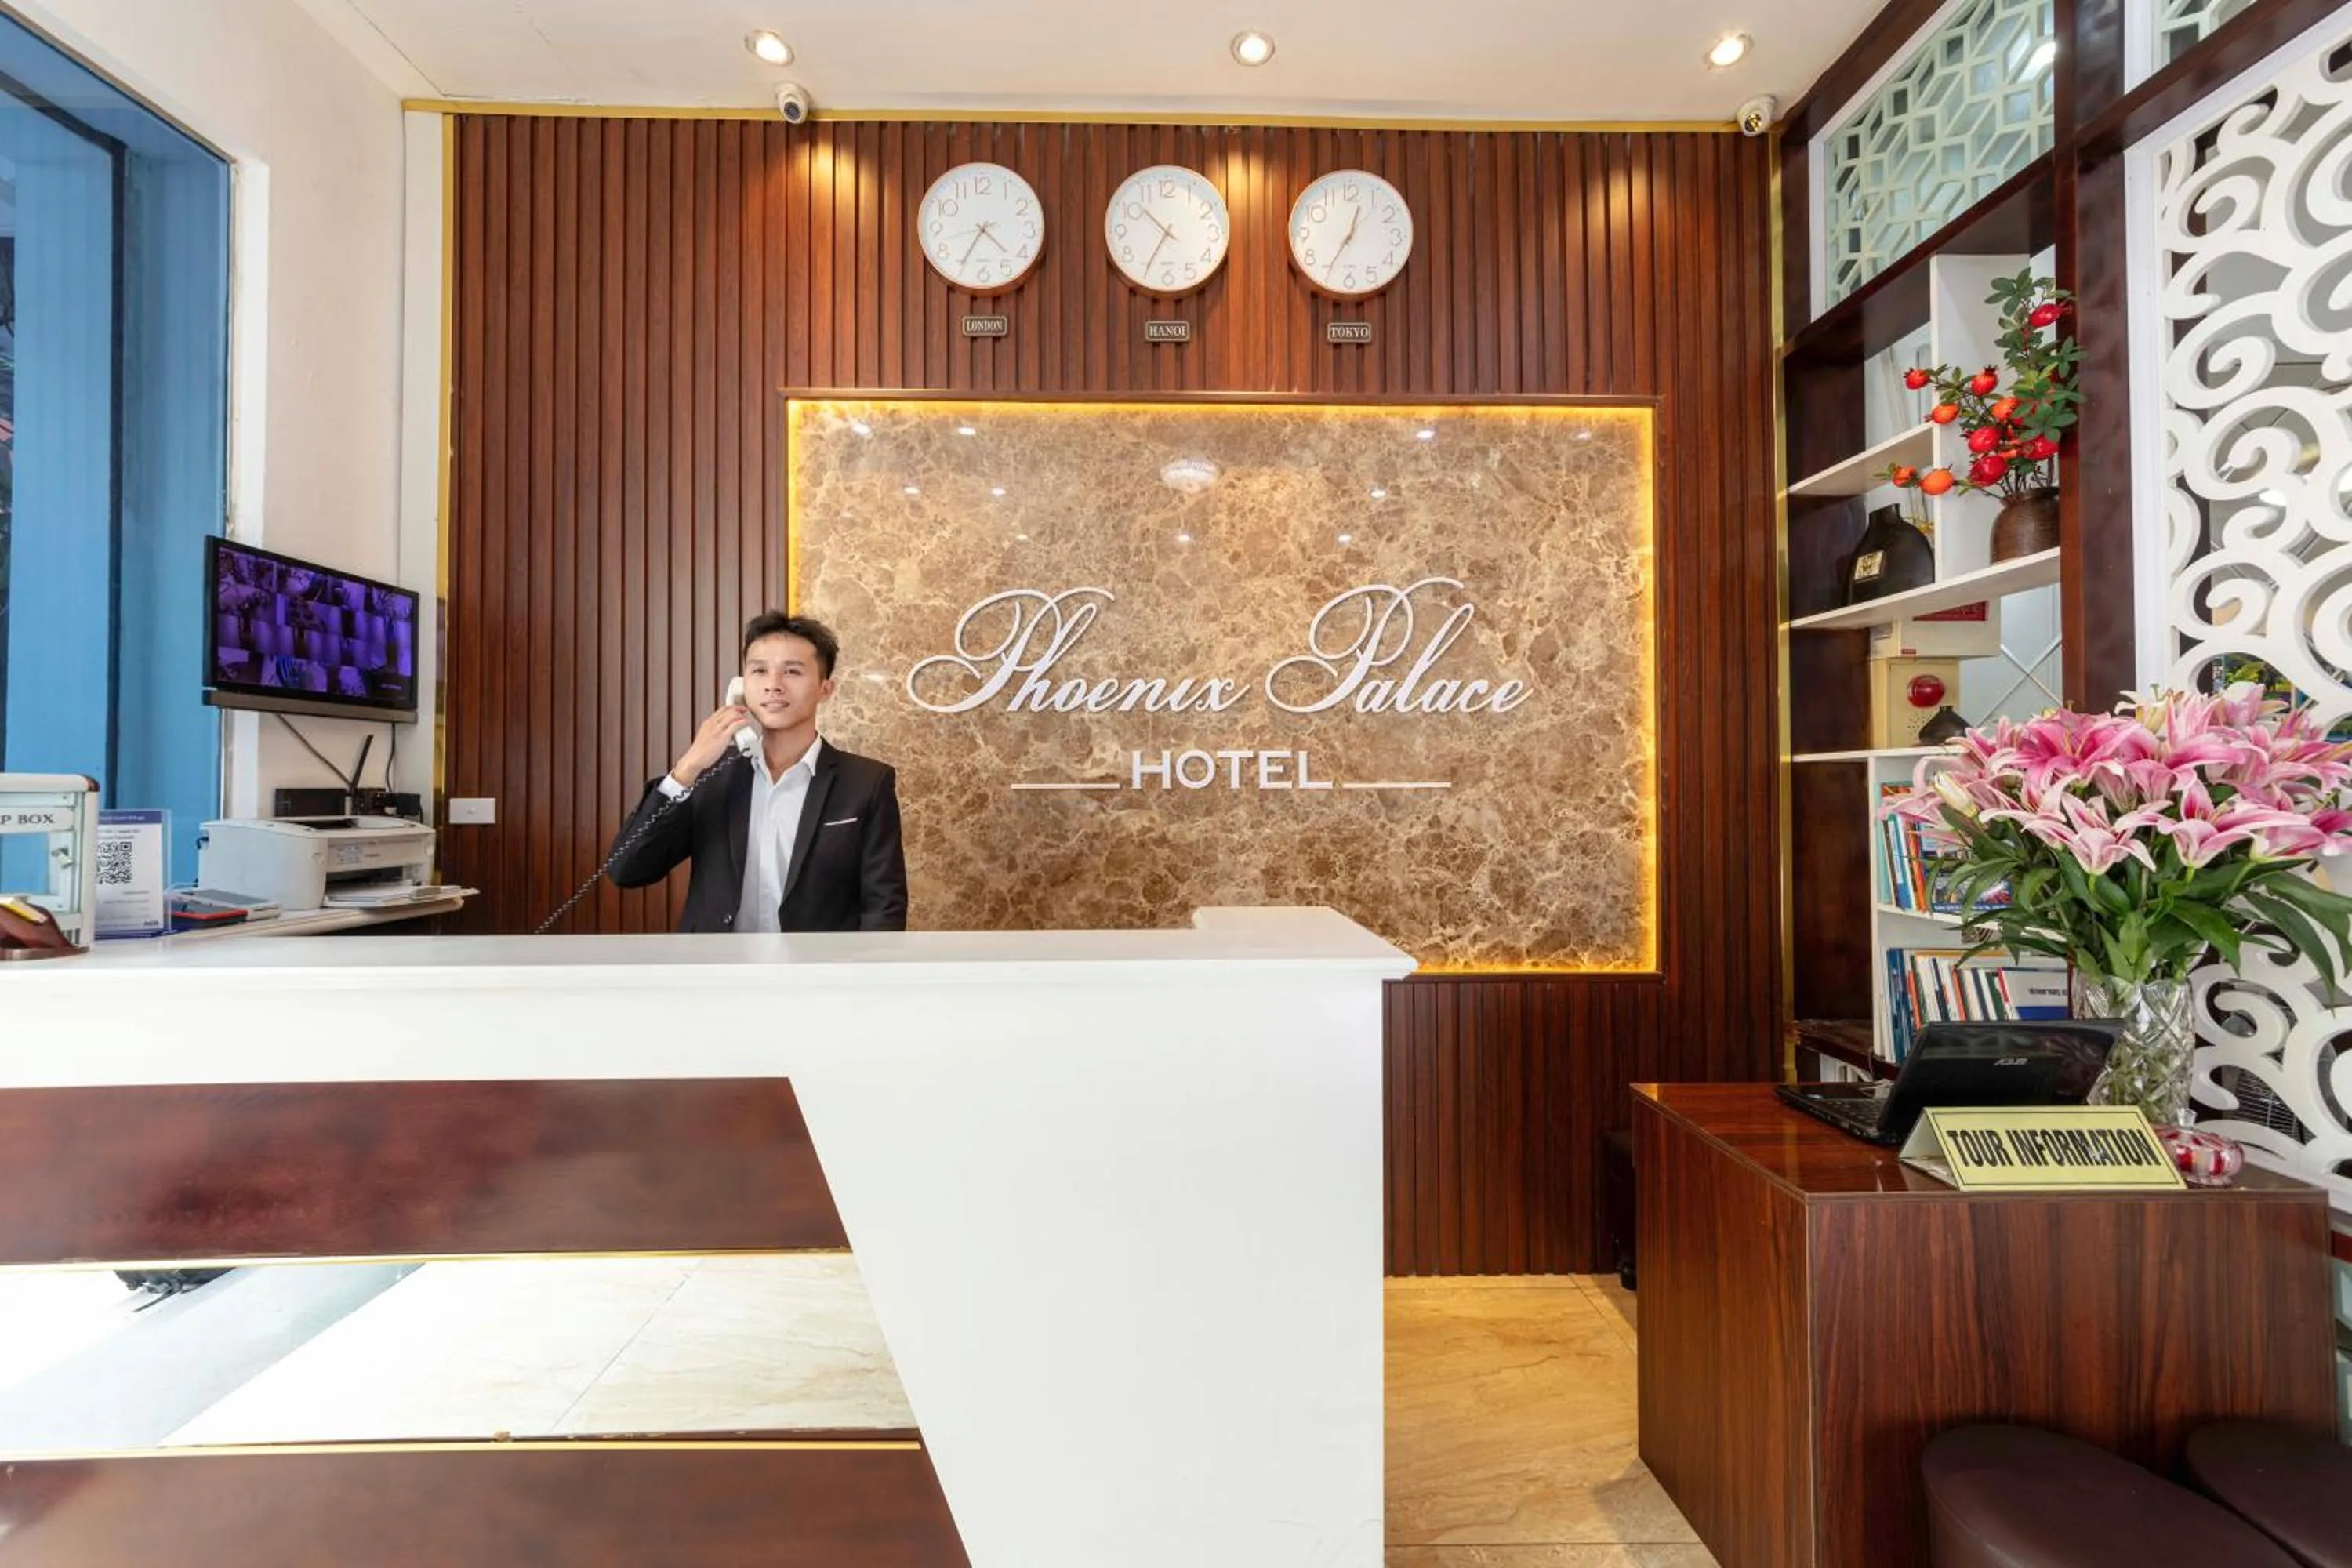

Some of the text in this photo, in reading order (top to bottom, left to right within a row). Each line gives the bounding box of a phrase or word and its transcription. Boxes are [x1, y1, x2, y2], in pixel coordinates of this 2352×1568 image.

[956, 181, 967, 199] 11
[975, 176, 991, 195] 12
[1140, 184, 1152, 203] 11
[1160, 180, 1175, 198] 12
[1343, 183, 1359, 202] 12
[1015, 197, 1028, 216] 2
[1324, 188, 1335, 207] 11
[938, 198, 958, 217] 10
[1123, 201, 1143, 220] 10
[1200, 201, 1213, 219] 2
[1307, 205, 1326, 223] 10
[1382, 205, 1396, 223] 2
[930, 221, 942, 237] 9
[1023, 220, 1036, 238] 3
[1115, 224, 1127, 240] 9
[1207, 223, 1220, 242] 3
[1299, 227, 1310, 244] 9
[1390, 228, 1402, 246] 3
[938, 243, 949, 260] 8
[1016, 244, 1029, 258] 4
[1122, 245, 1134, 263] 8
[1200, 248, 1211, 263] 4
[1304, 249, 1316, 265] 8
[1382, 251, 1393, 268] 4
[977, 265, 990, 282] 6
[1000, 260, 1012, 276] 5
[1185, 263, 1196, 280] 5
[1366, 266, 1377, 283] 5
[1162, 269, 1174, 286] 6
[1343, 271, 1355, 289] 6
[967, 320, 1003, 330] LONDON
[1149, 325, 1185, 336] HANOI
[1331, 326, 1368, 337] TOKYO
[906, 577, 1534, 713] Phoenix Palace
[1131, 750, 1333, 789] HOTEL
[18, 815, 55, 824] BOX
[1946, 1129, 2161, 1167] TOUR INFORMATION
